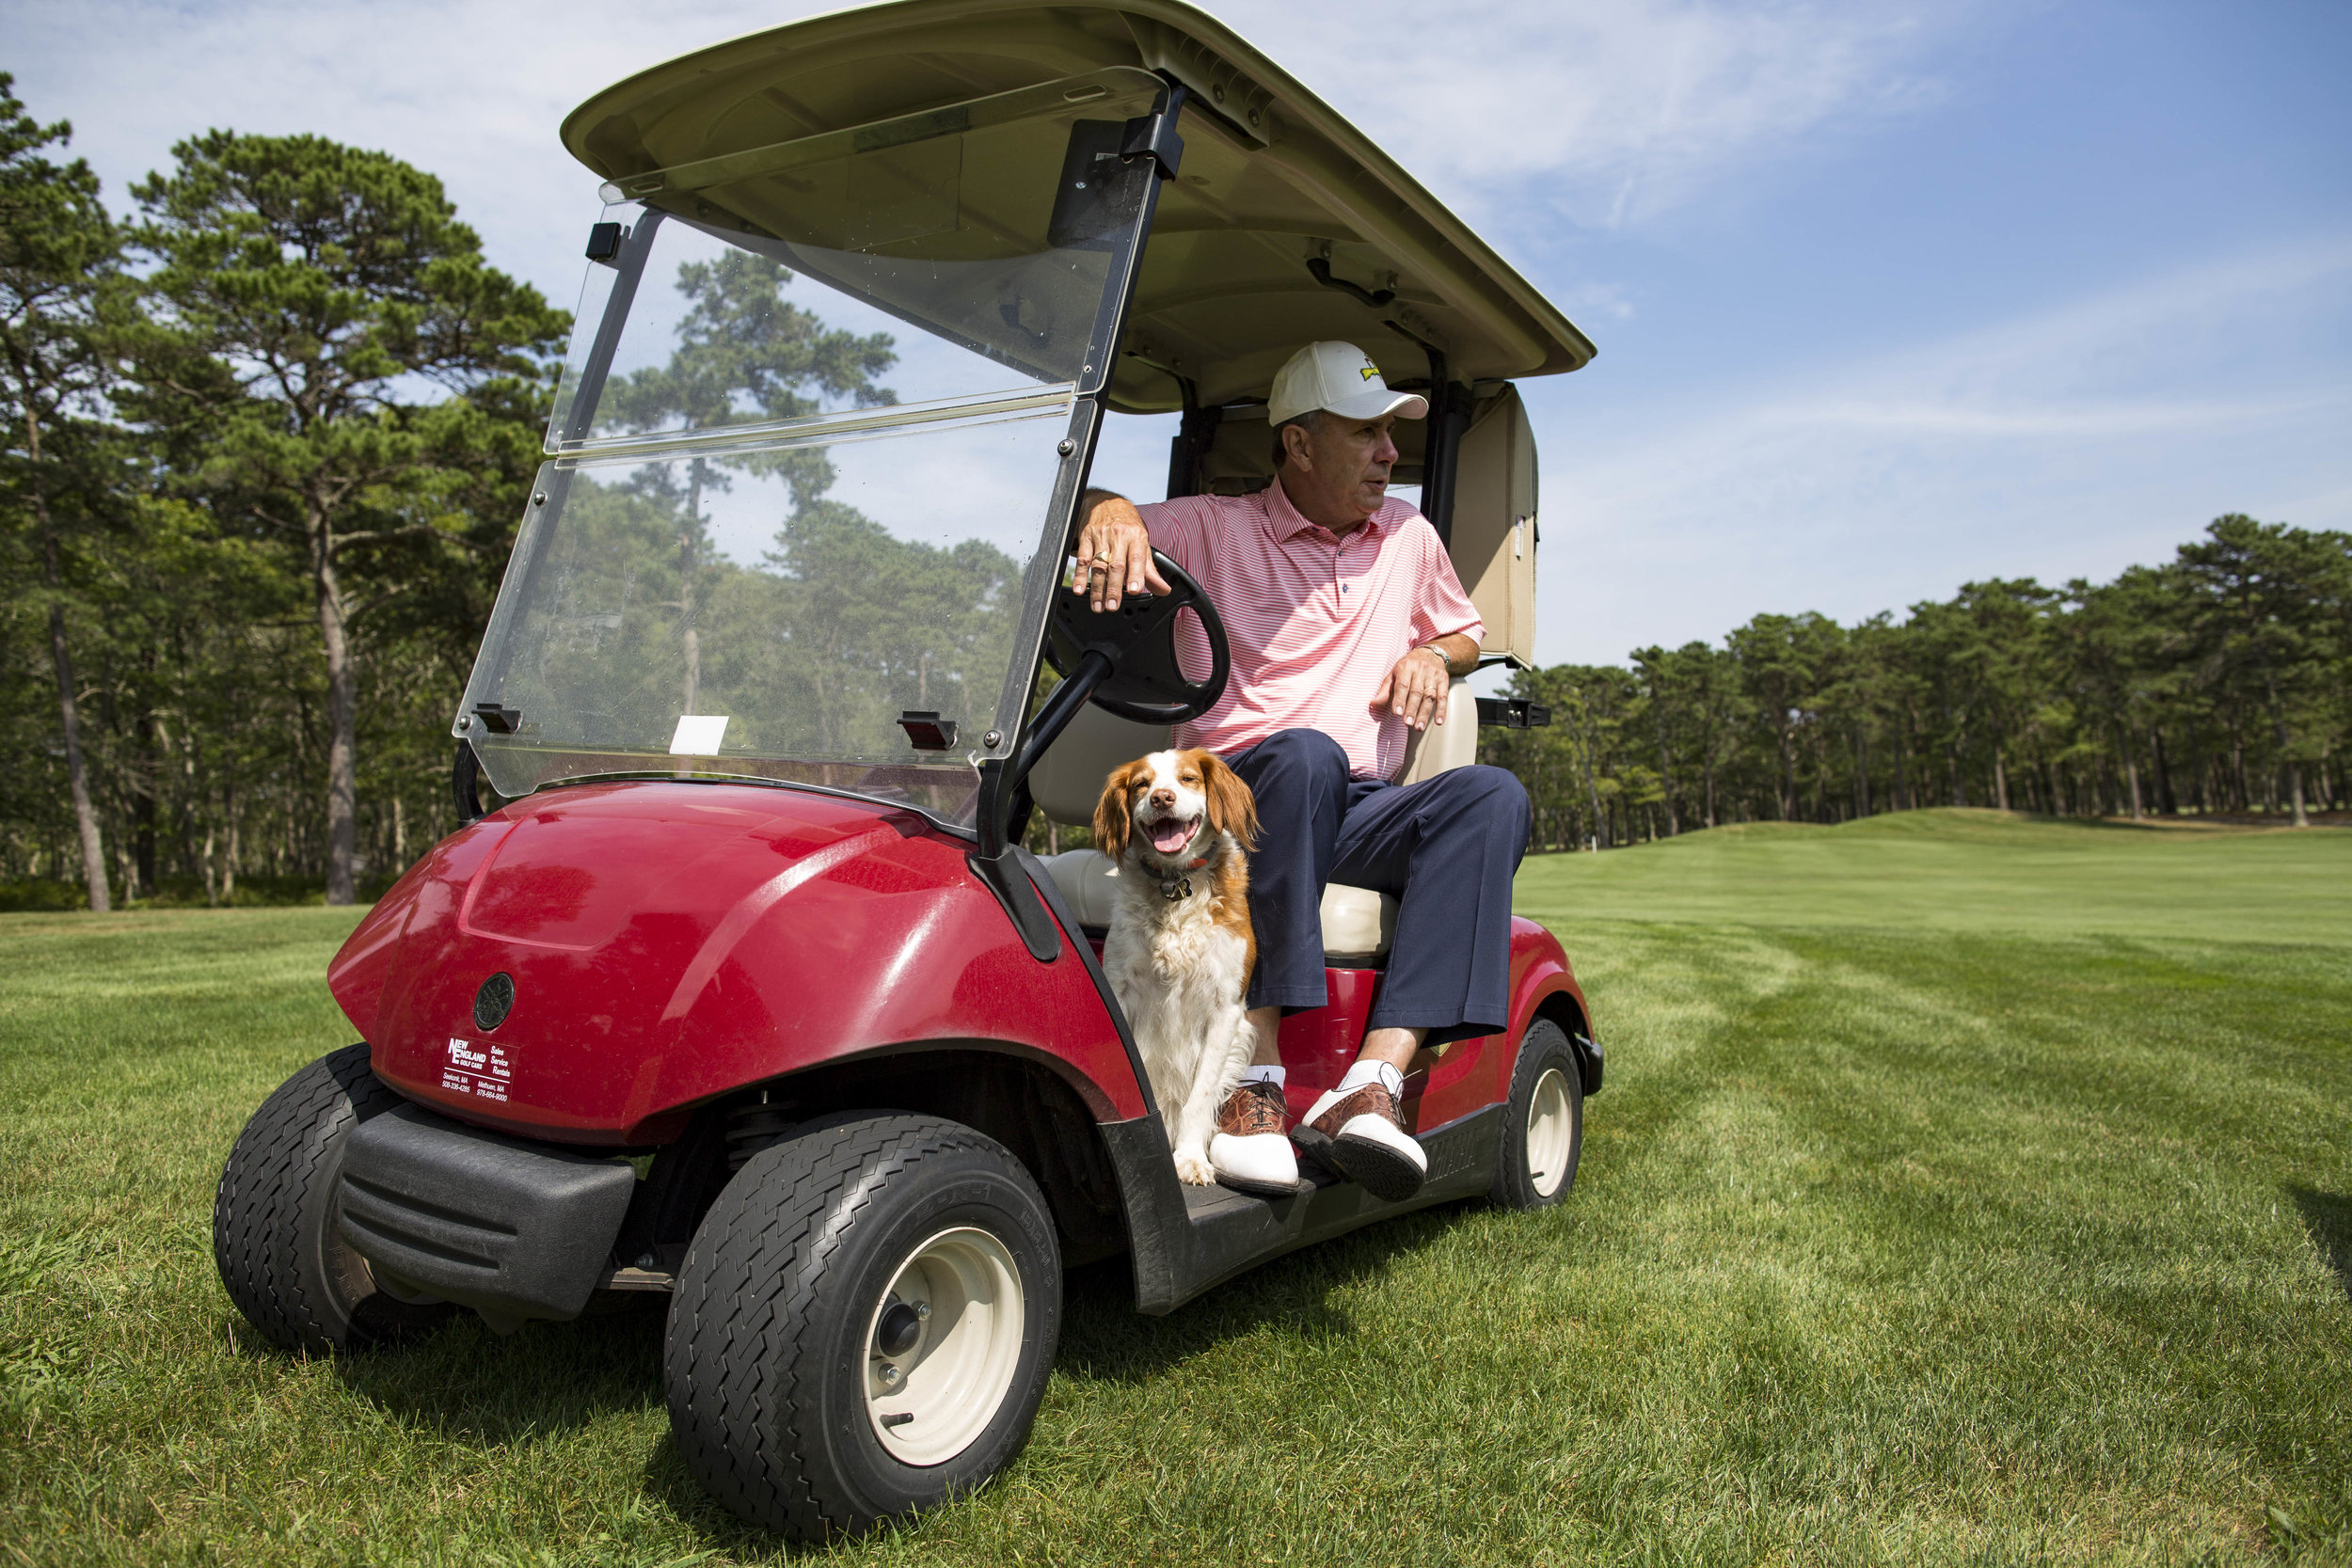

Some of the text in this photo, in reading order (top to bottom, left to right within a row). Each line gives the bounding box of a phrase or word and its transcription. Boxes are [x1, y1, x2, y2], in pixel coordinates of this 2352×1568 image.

[448, 1037, 469, 1053] NEW
[491, 1046, 504, 1055] Sales
[452, 1050, 486, 1064] ENGLAND
[491, 1056, 508, 1067] Service
[460, 1059, 483, 1069] GOLF CARS
[493, 1066, 511, 1077] Rentals
[461, 1076, 469, 1085] MA
[497, 1085, 504, 1093] MA
